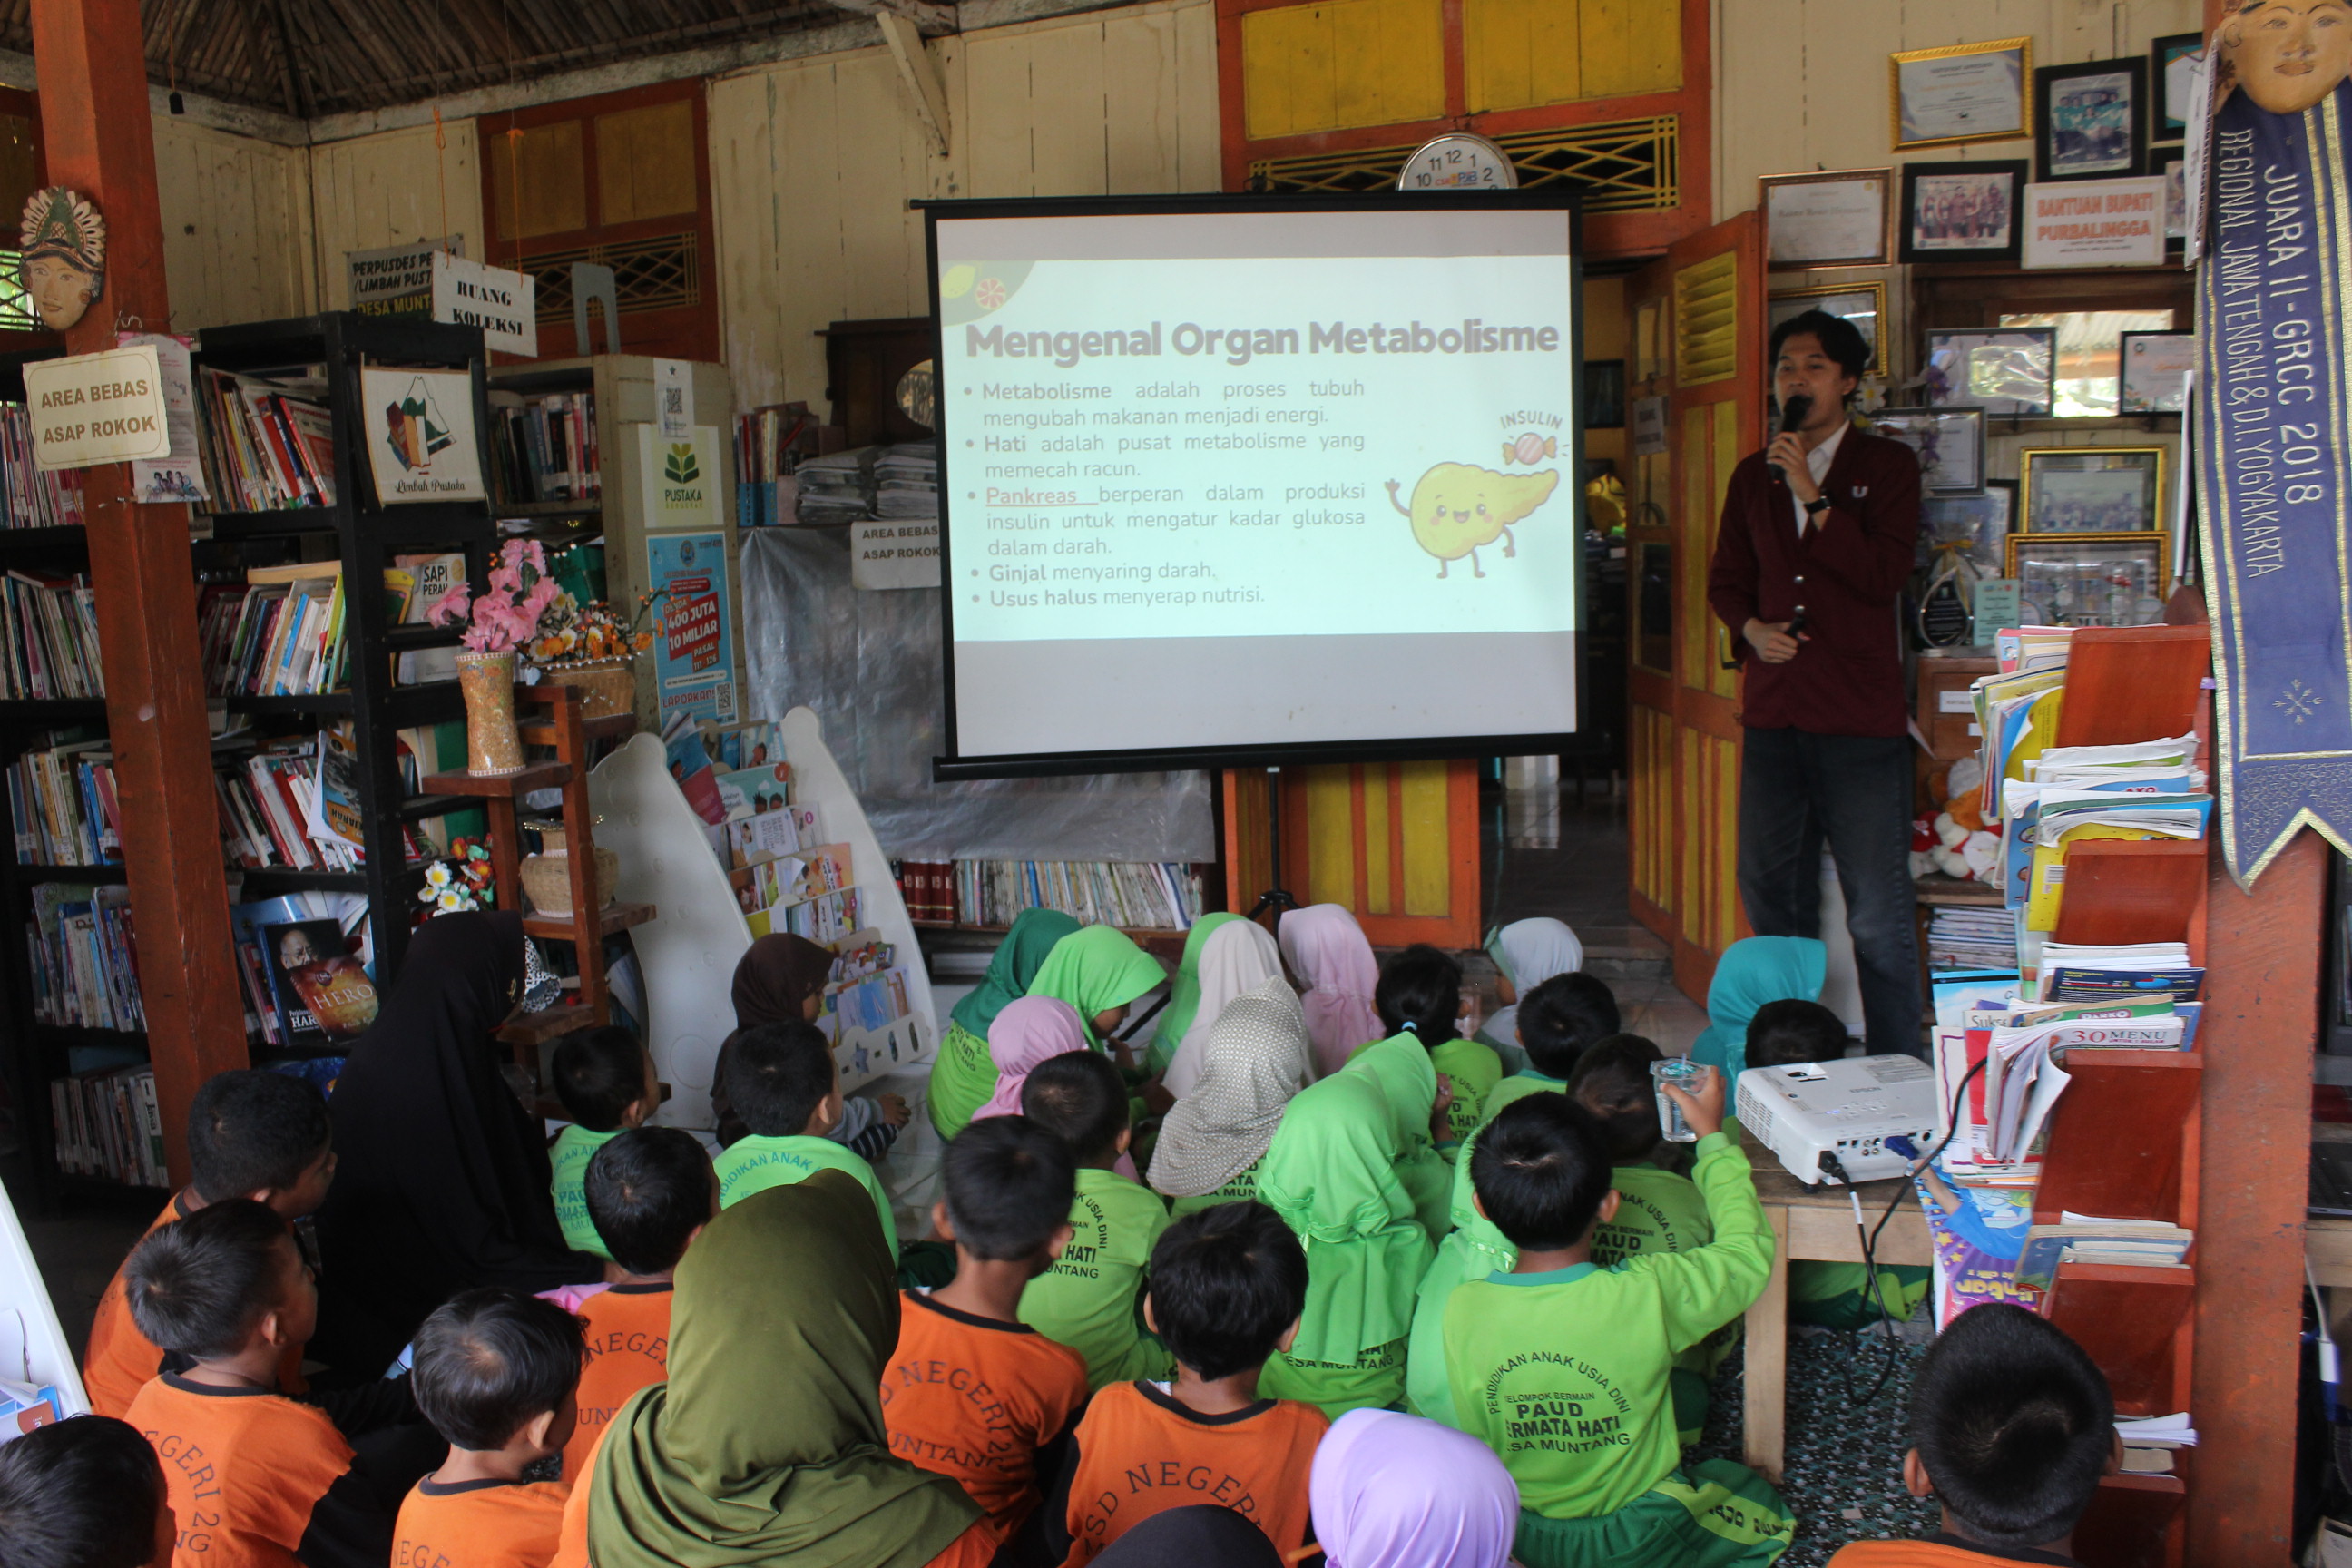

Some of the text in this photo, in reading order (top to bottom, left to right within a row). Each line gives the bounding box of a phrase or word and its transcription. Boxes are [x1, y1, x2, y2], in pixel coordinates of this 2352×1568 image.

[1428, 157, 1441, 171] 11
[1446, 149, 1462, 163] 12
[1469, 153, 1475, 167] 1
[1416, 172, 1432, 187] 10
[1483, 167, 1493, 181] 2
[2219, 128, 2259, 236] REGIONAL
[2038, 192, 2153, 217] BANTUAN BUPATI
[2264, 163, 2308, 266] JUARA
[2037, 220, 2151, 241] PURBALINGGA
[352, 254, 416, 276] PERPUSDES
[2220, 240, 2262, 296] JAWA
[355, 270, 431, 294] (LIMBAH PUST
[358, 293, 431, 316] DESA MUNT
[457, 281, 512, 306] RUANG
[453, 309, 522, 336] KOLEKSI
[965, 318, 1560, 368] Mengenal Organ Metabolisme
[2224, 293, 2268, 383] TENGAH
[41, 379, 149, 408] AREA BEBAS
[982, 379, 1365, 401] Metabolisme adalah proses tubuh
[984, 407, 1329, 430] mengubah makanan menjadi energi.
[1499, 409, 1563, 430] INSULIN
[44, 416, 156, 444] ASAP ROKOK
[985, 432, 1366, 454] Hati adalah pusat metabolisme yang
[985, 461, 1141, 478] memecah racun.
[2279, 423, 2325, 505] 2018
[395, 479, 465, 494] Limbah Pustaka
[665, 489, 701, 501] PUSTAKA
[985, 484, 1366, 506] Pankreas berperan dalam produksi
[2235, 439, 2285, 579] YOGYAKARTA
[987, 508, 1366, 533] insulin untuk mengatur kadar glukosa
[863, 526, 938, 539] AREA BEBAS
[863, 547, 940, 560] ASAP ROKOK
[988, 537, 1112, 556] dalam darah.
[424, 565, 448, 582] SAPI
[988, 561, 1217, 583] Ginjal menyaring darah.
[990, 587, 1265, 609] Usus halus menyerap nutrisi.
[668, 600, 716, 629] 400 JUTA
[669, 620, 717, 651] 10 MILIAR
[694, 642, 715, 657] PASAL
[314, 985, 373, 1010] HERO
[290, 1014, 318, 1028] HAR
[1972, 1015, 2007, 1027] Sukse
[2070, 1031, 2167, 1044] 30 MENU
[719, 1152, 813, 1205] NDIDIKAN ANAK
[559, 1191, 586, 1203] PAU
[1620, 1191, 1646, 1208] NAK
[1647, 1204, 1670, 1230] USIA
[1085, 1198, 1108, 1249] USIA DINI
[1065, 1245, 1096, 1263] HATI
[586, 1332, 668, 1367] NEGE
[1486, 1351, 1632, 1415] PENDIDIKAN ANAK USIA DINI
[897, 1360, 1012, 1433] NEGERI
[1553, 1391, 1595, 1400] BERMAIN
[1516, 1401, 1583, 1419] PAUD
[1505, 1416, 1621, 1438] RMATA HATI
[1540, 1432, 1631, 1454] MUNTANG
[143, 1430, 220, 1501] EGERI
[192, 1512, 220, 1528] 2
[1085, 1491, 1119, 1536] SD
